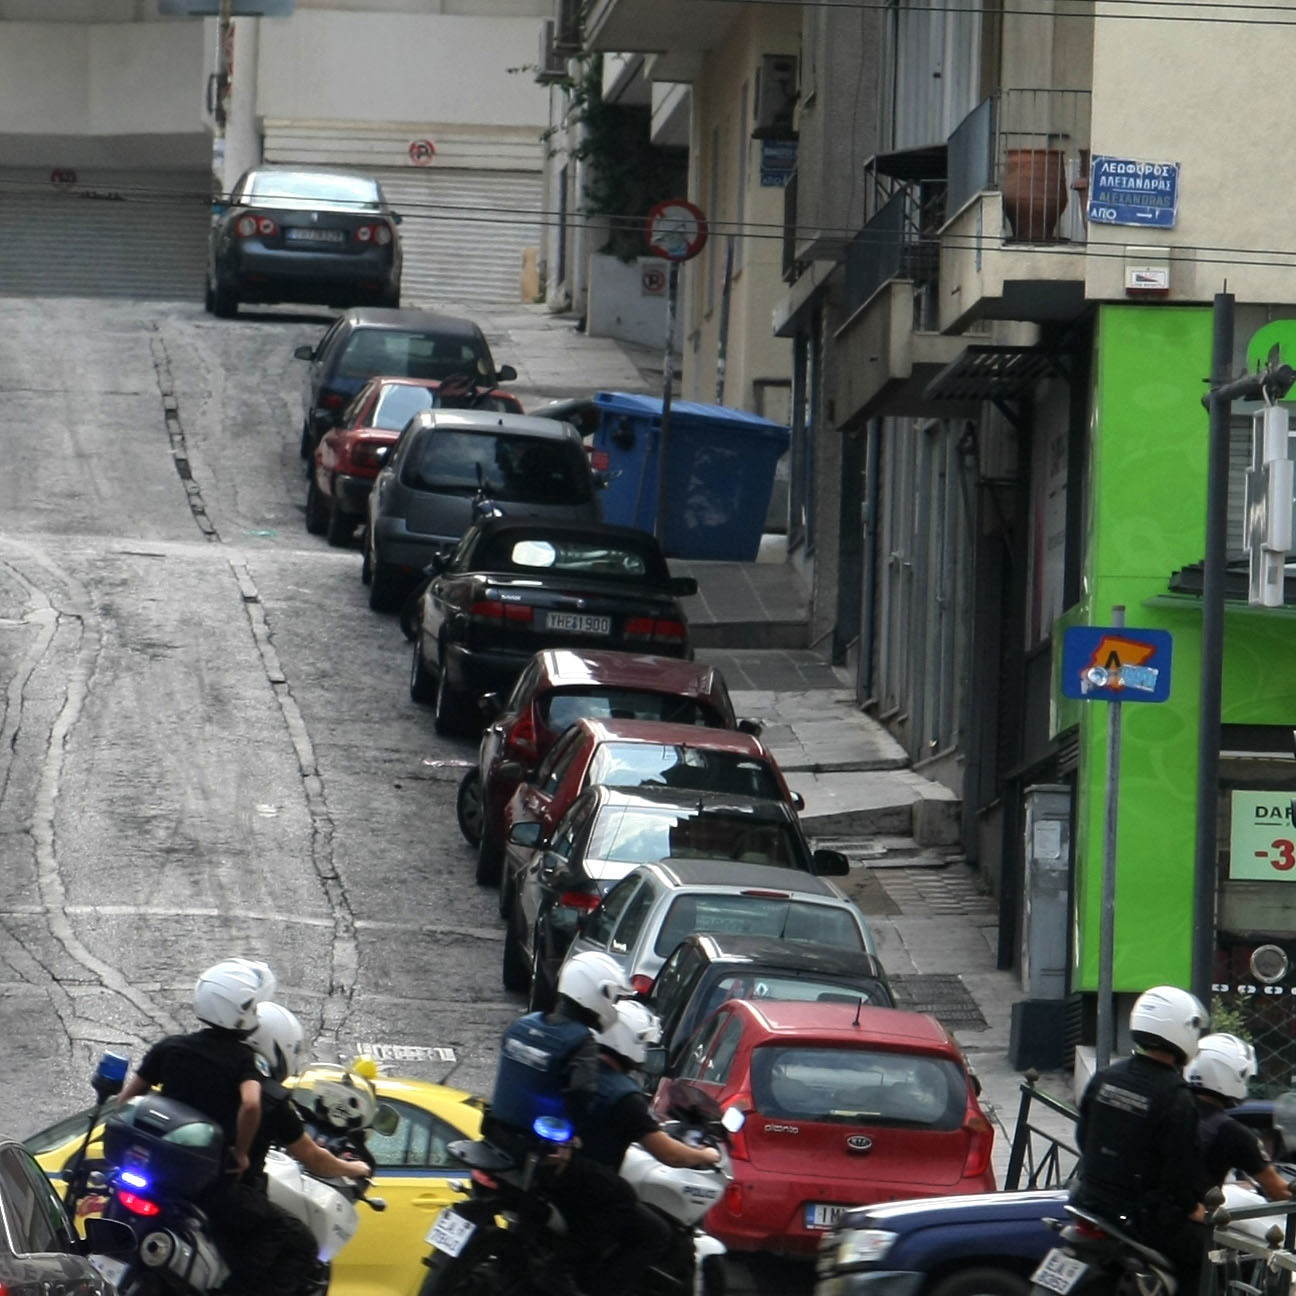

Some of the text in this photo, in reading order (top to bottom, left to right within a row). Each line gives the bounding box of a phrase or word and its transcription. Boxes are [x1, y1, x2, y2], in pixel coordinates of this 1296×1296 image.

[1101, 162, 1170, 177] ΛΕΩΦΟΡΟΣ
[1099, 176, 1172, 191] ΑΛΕΞΑΝΔΡΑΣ
[1091, 208, 1117, 219] ΑΠΟ
